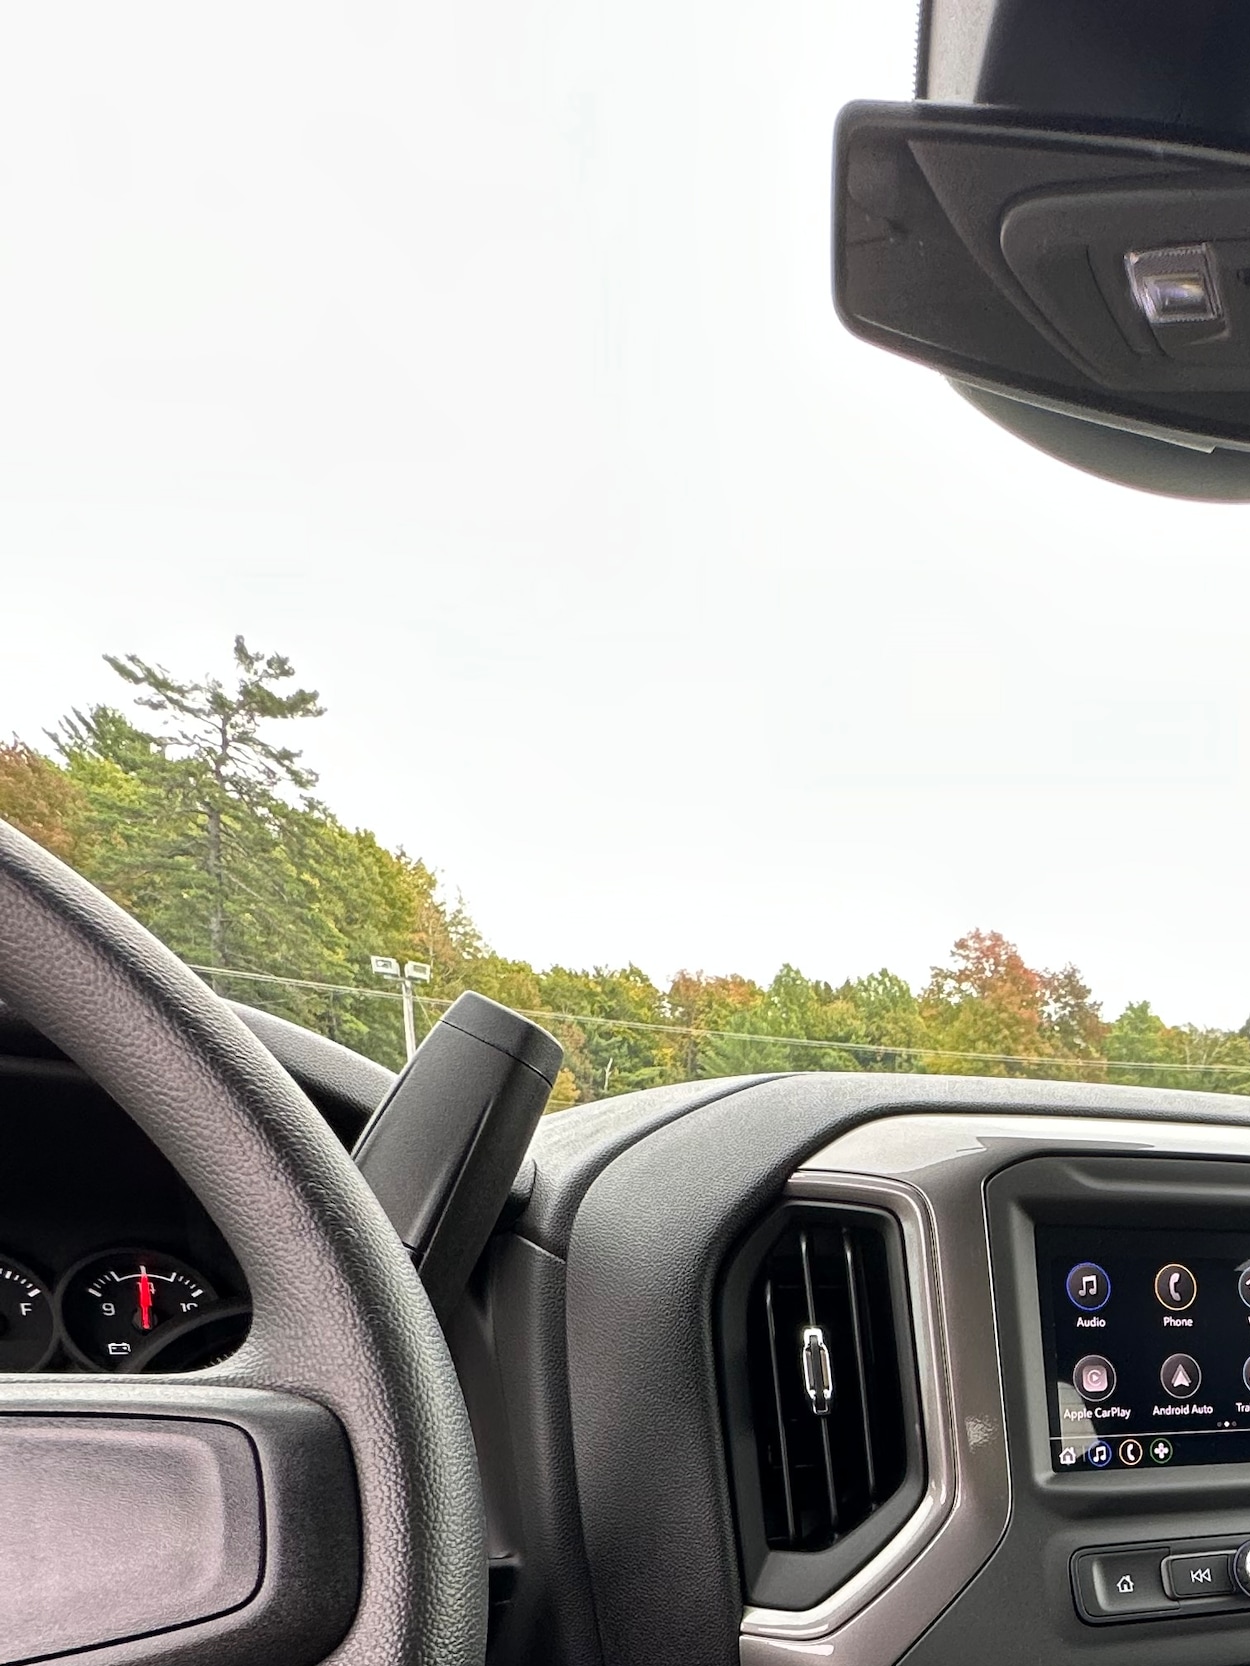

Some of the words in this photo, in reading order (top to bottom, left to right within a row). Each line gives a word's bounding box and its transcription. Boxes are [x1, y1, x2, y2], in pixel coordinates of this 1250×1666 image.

[20, 1302, 33, 1316] F
[102, 1302, 116, 1316] 9
[1076, 1316, 1106, 1328] Audio
[1163, 1316, 1194, 1328] Phone
[1063, 1408, 1091, 1420] Apple
[1092, 1406, 1131, 1420] CarPlay
[1152, 1404, 1189, 1416] Android
[1191, 1403, 1213, 1415] Auto
